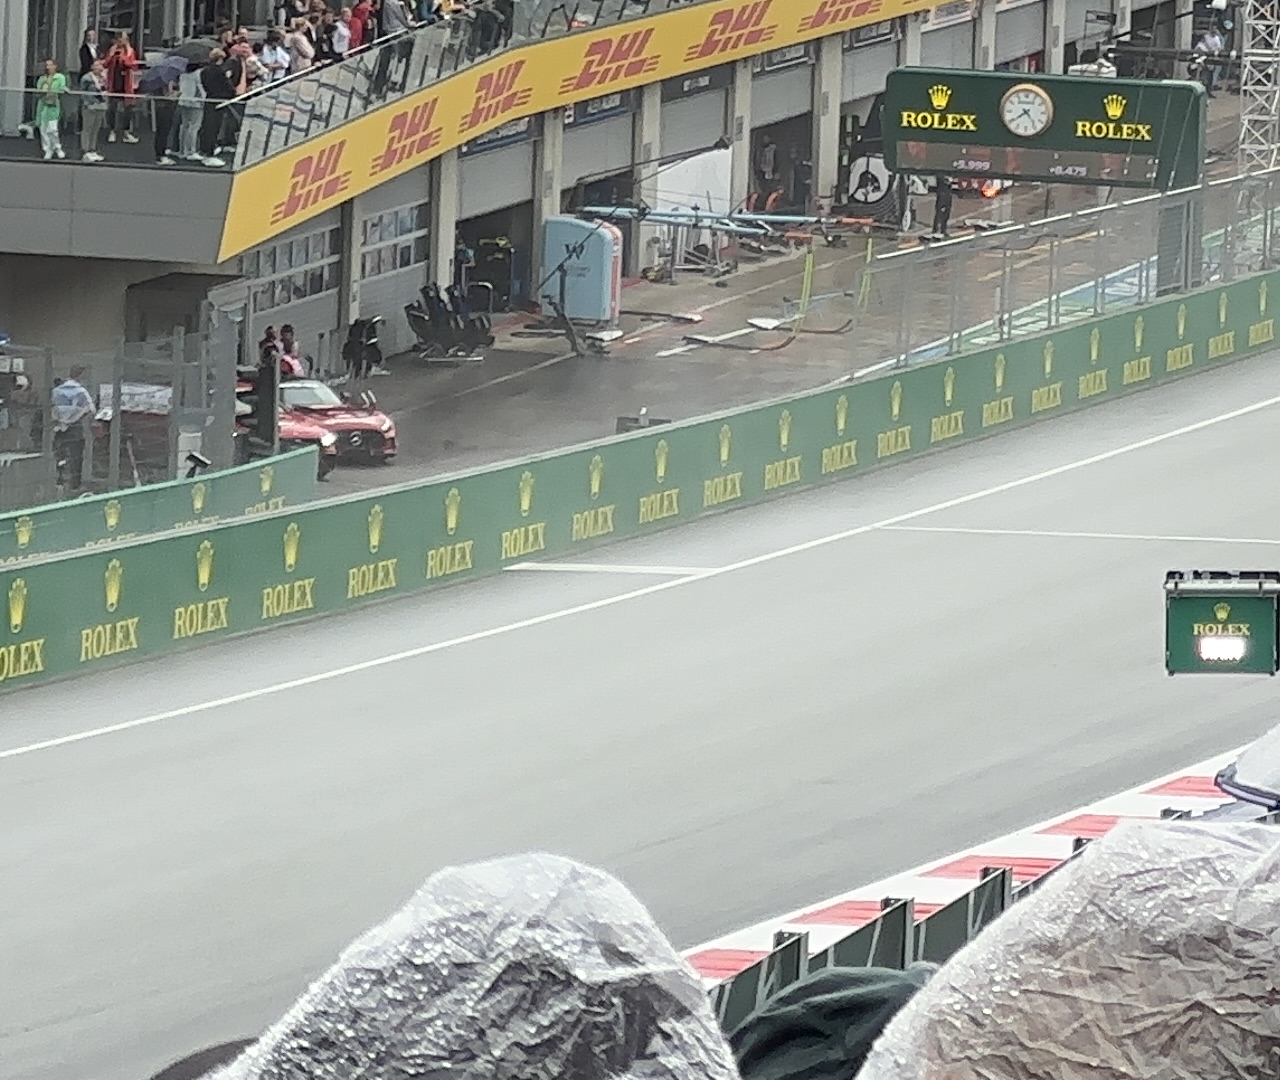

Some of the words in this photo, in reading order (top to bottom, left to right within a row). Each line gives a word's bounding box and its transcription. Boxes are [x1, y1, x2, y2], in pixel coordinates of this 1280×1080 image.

[686, 0, 777, 62] DHL
[561, 28, 661, 95] DHL
[460, 60, 532, 133] DHL
[371, 97, 442, 176] DHL
[900, 111, 978, 132] ROLEX
[1074, 120, 1153, 141] ROLEX
[272, 140, 351, 224] DHL
[702, 473, 741, 505] ROLEX
[764, 458, 801, 489] ROLEX
[573, 506, 614, 539] ROLEX
[638, 489, 679, 522] ROLEX
[427, 541, 473, 578] ROLEX
[502, 523, 546, 559] ROLEX
[348, 559, 397, 597] ROLEX
[262, 579, 315, 618] ROLEX
[173, 598, 229, 639] ROLEX
[1192, 623, 1251, 636] ROLEX
[81, 618, 139, 660] ROLEX
[0, 639, 45, 682] OLEX
